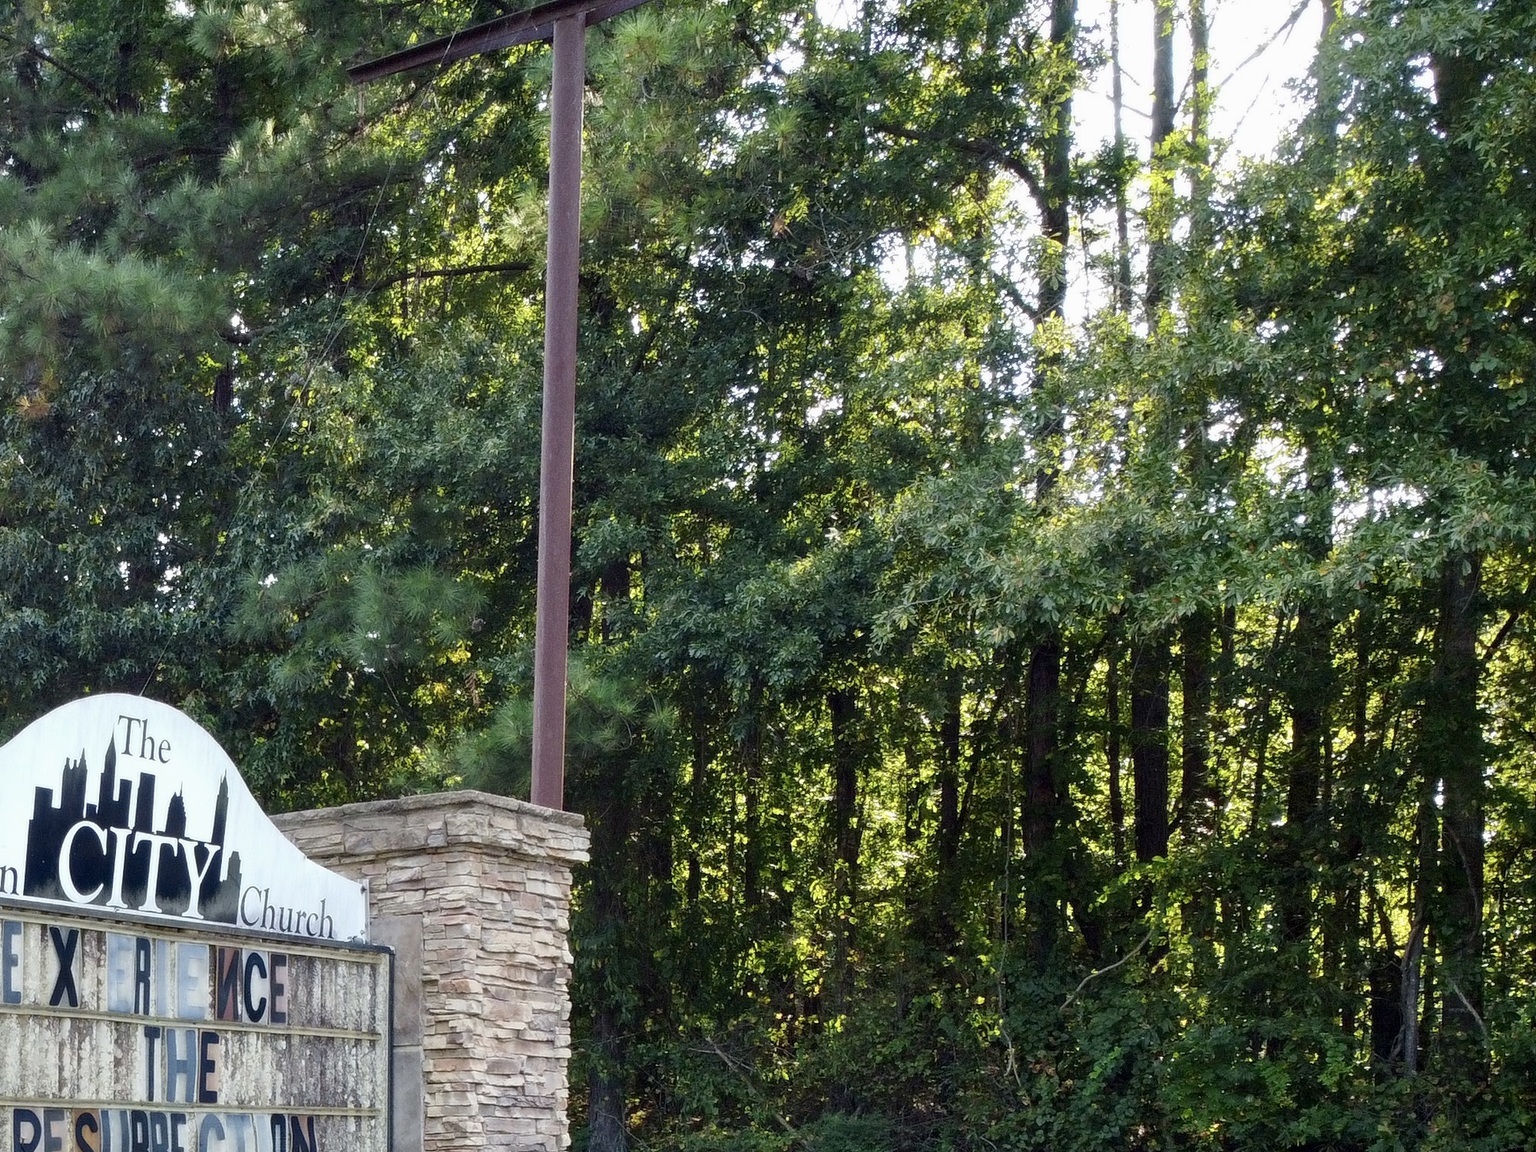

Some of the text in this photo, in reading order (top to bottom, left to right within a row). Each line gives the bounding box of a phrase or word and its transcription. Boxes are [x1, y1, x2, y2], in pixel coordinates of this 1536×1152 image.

[118, 714, 171, 764] The
[58, 820, 221, 920] CITY
[240, 885, 335, 940] Church
[144, 1026, 220, 1104] THE
